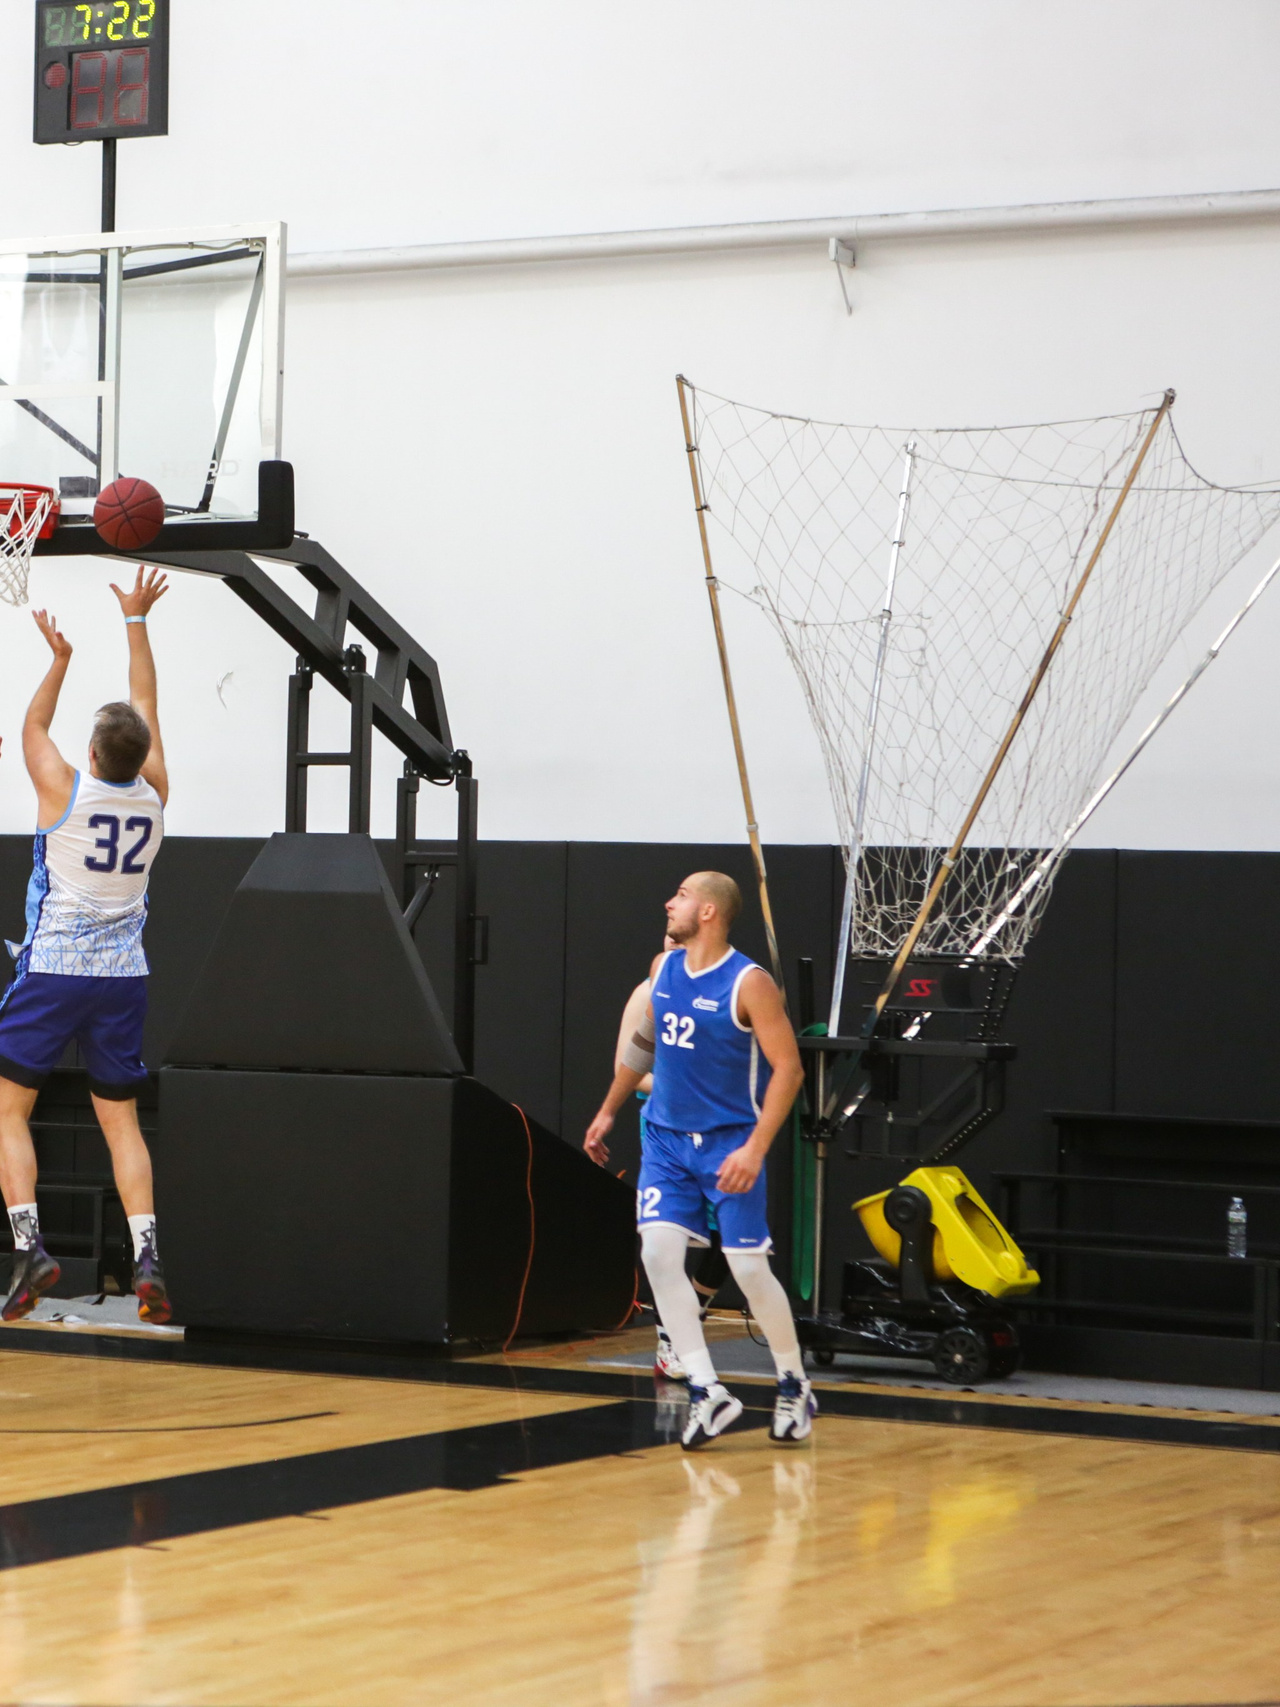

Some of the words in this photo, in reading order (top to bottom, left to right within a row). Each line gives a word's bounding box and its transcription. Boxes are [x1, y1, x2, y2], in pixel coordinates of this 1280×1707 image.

[75, 0, 156, 41] 7:22
[84, 813, 153, 875] 32
[661, 1012, 695, 1050] 32
